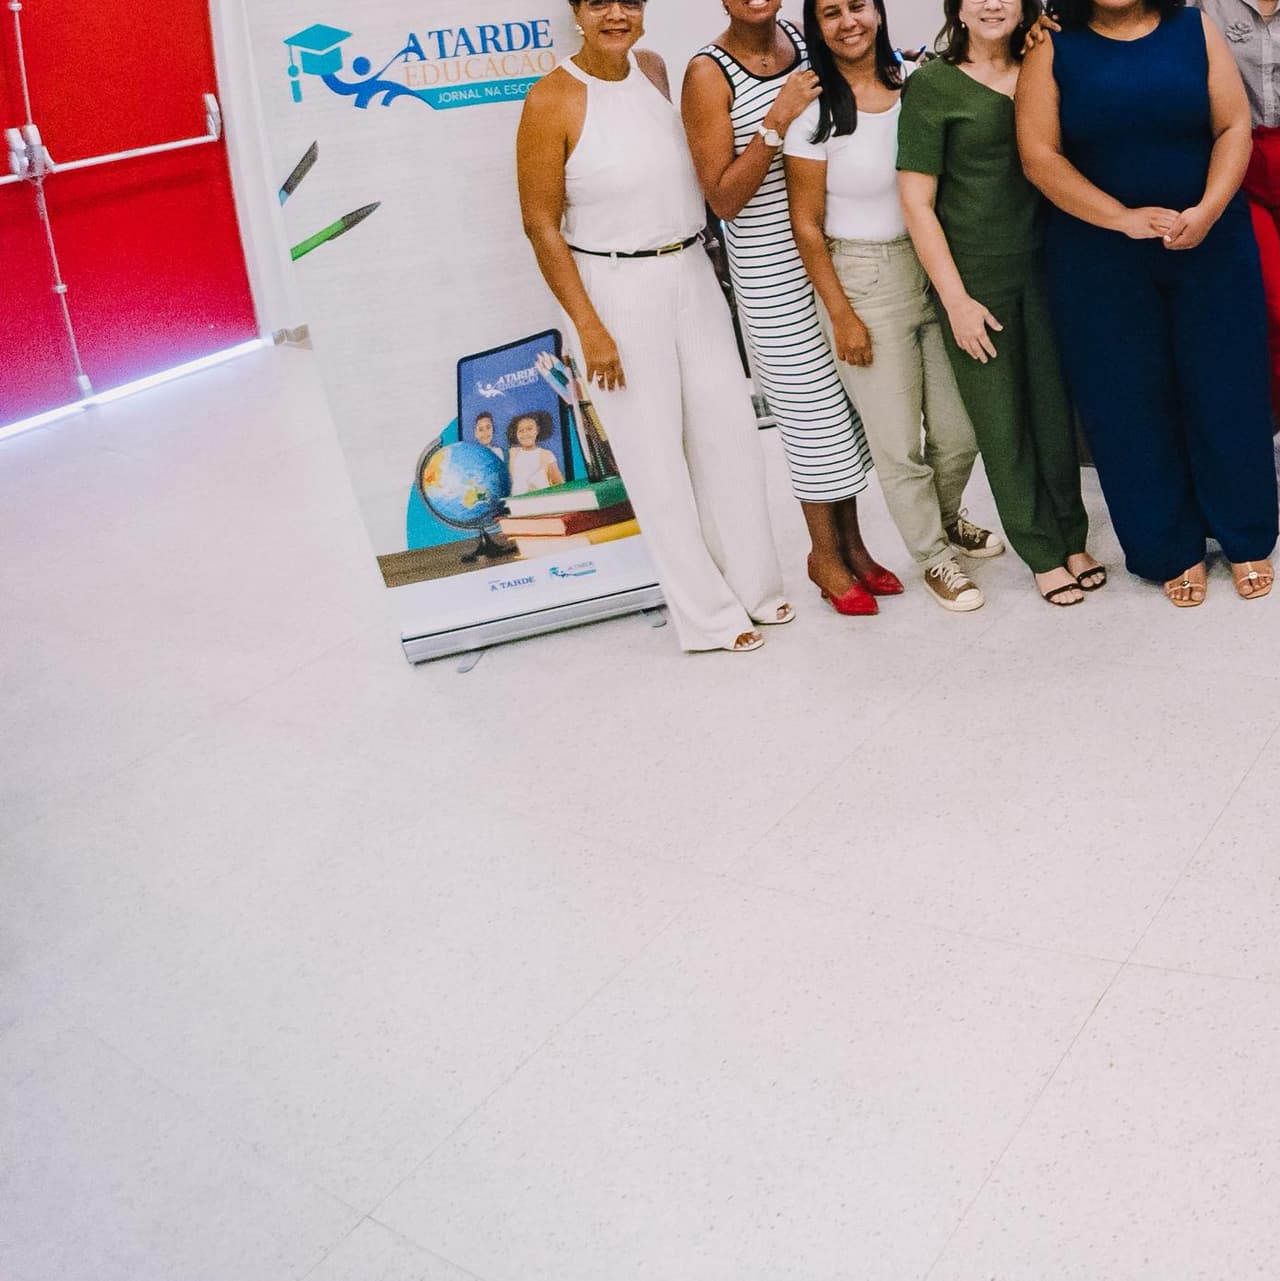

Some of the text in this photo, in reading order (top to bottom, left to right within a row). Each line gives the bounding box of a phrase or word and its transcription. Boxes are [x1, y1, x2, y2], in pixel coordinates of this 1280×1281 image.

[402, 19, 554, 63] A TARDE
[437, 82, 533, 104] JORNAL NA ESCO
